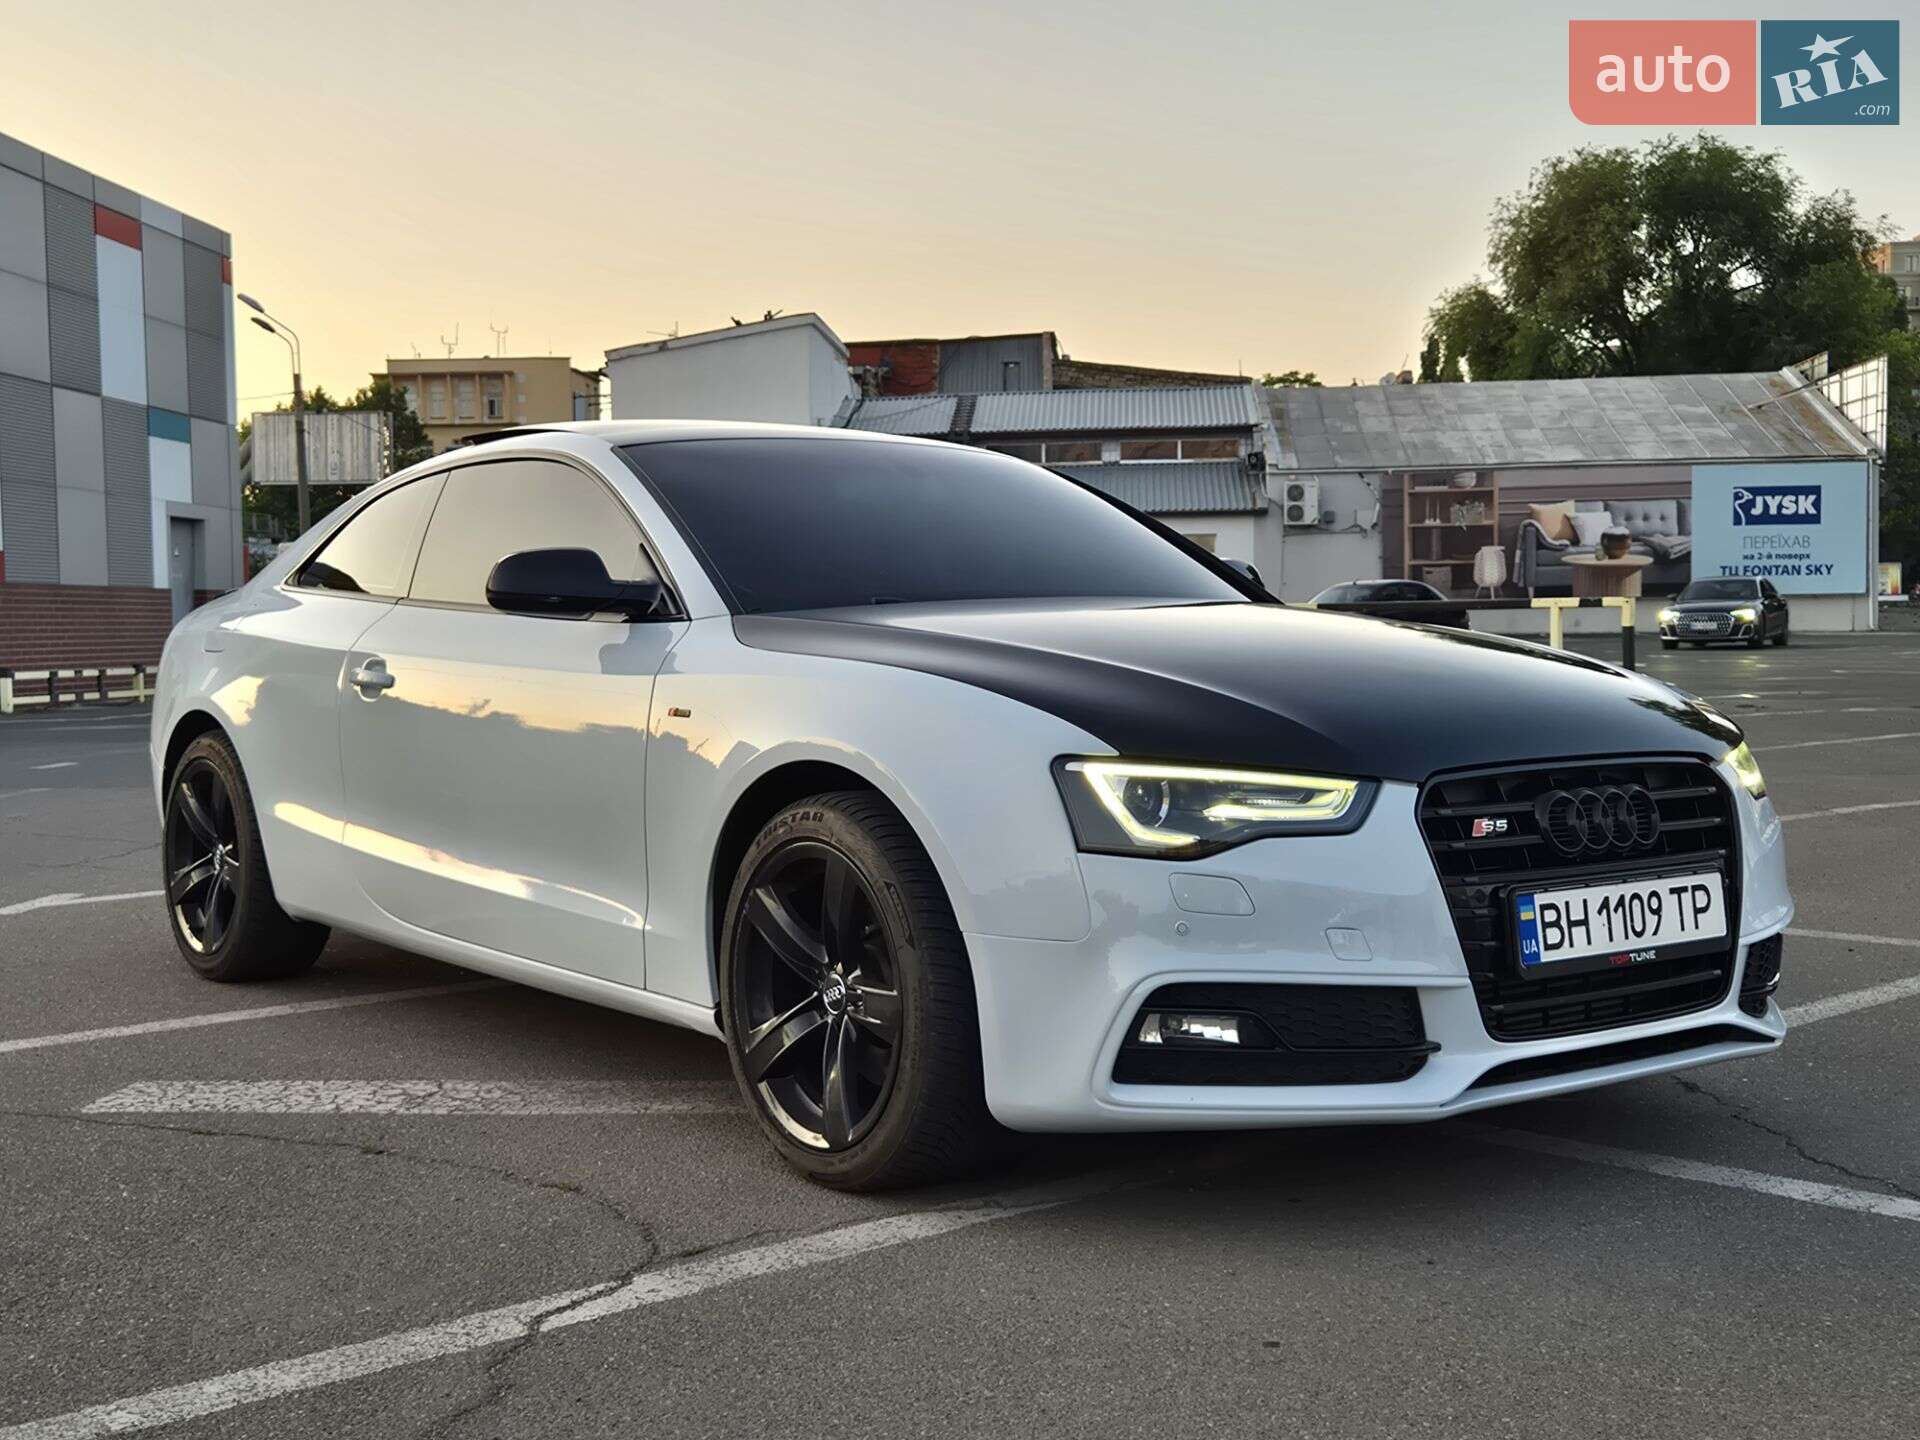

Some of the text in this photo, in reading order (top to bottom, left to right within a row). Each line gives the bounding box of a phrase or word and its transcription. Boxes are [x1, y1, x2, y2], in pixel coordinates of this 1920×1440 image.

[1750, 495, 1818, 515] JYSK
[1743, 533, 1811, 549] ПЕРЕЇХАВ
[1743, 564, 1802, 577] FONTAN
[1805, 564, 1835, 576] SKY
[1481, 819, 1508, 832] S5
[1539, 884, 1712, 951] BH 1109 TP
[1523, 938, 1539, 954] UA
